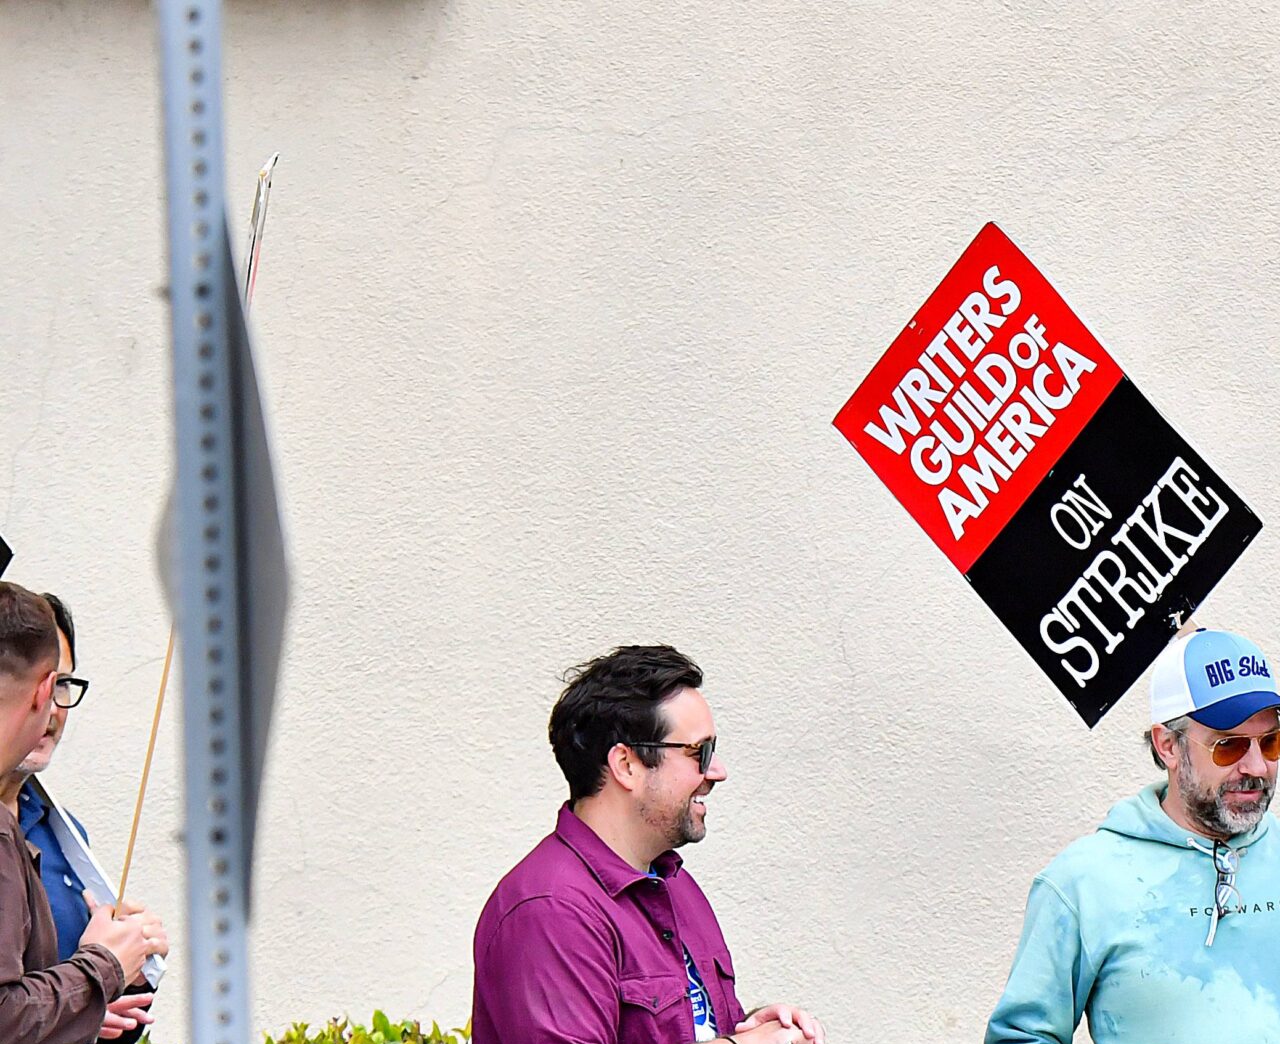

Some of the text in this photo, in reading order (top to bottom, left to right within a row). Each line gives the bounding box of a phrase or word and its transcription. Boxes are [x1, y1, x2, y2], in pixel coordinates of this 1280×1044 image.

[863, 265, 1022, 455] WRITERS
[910, 313, 1050, 486] GUILD OF
[937, 341, 1098, 541] AMERICA
[1039, 456, 1230, 688] STRIKE
[1050, 473, 1112, 550] ON
[1205, 658, 1236, 688] BIG
